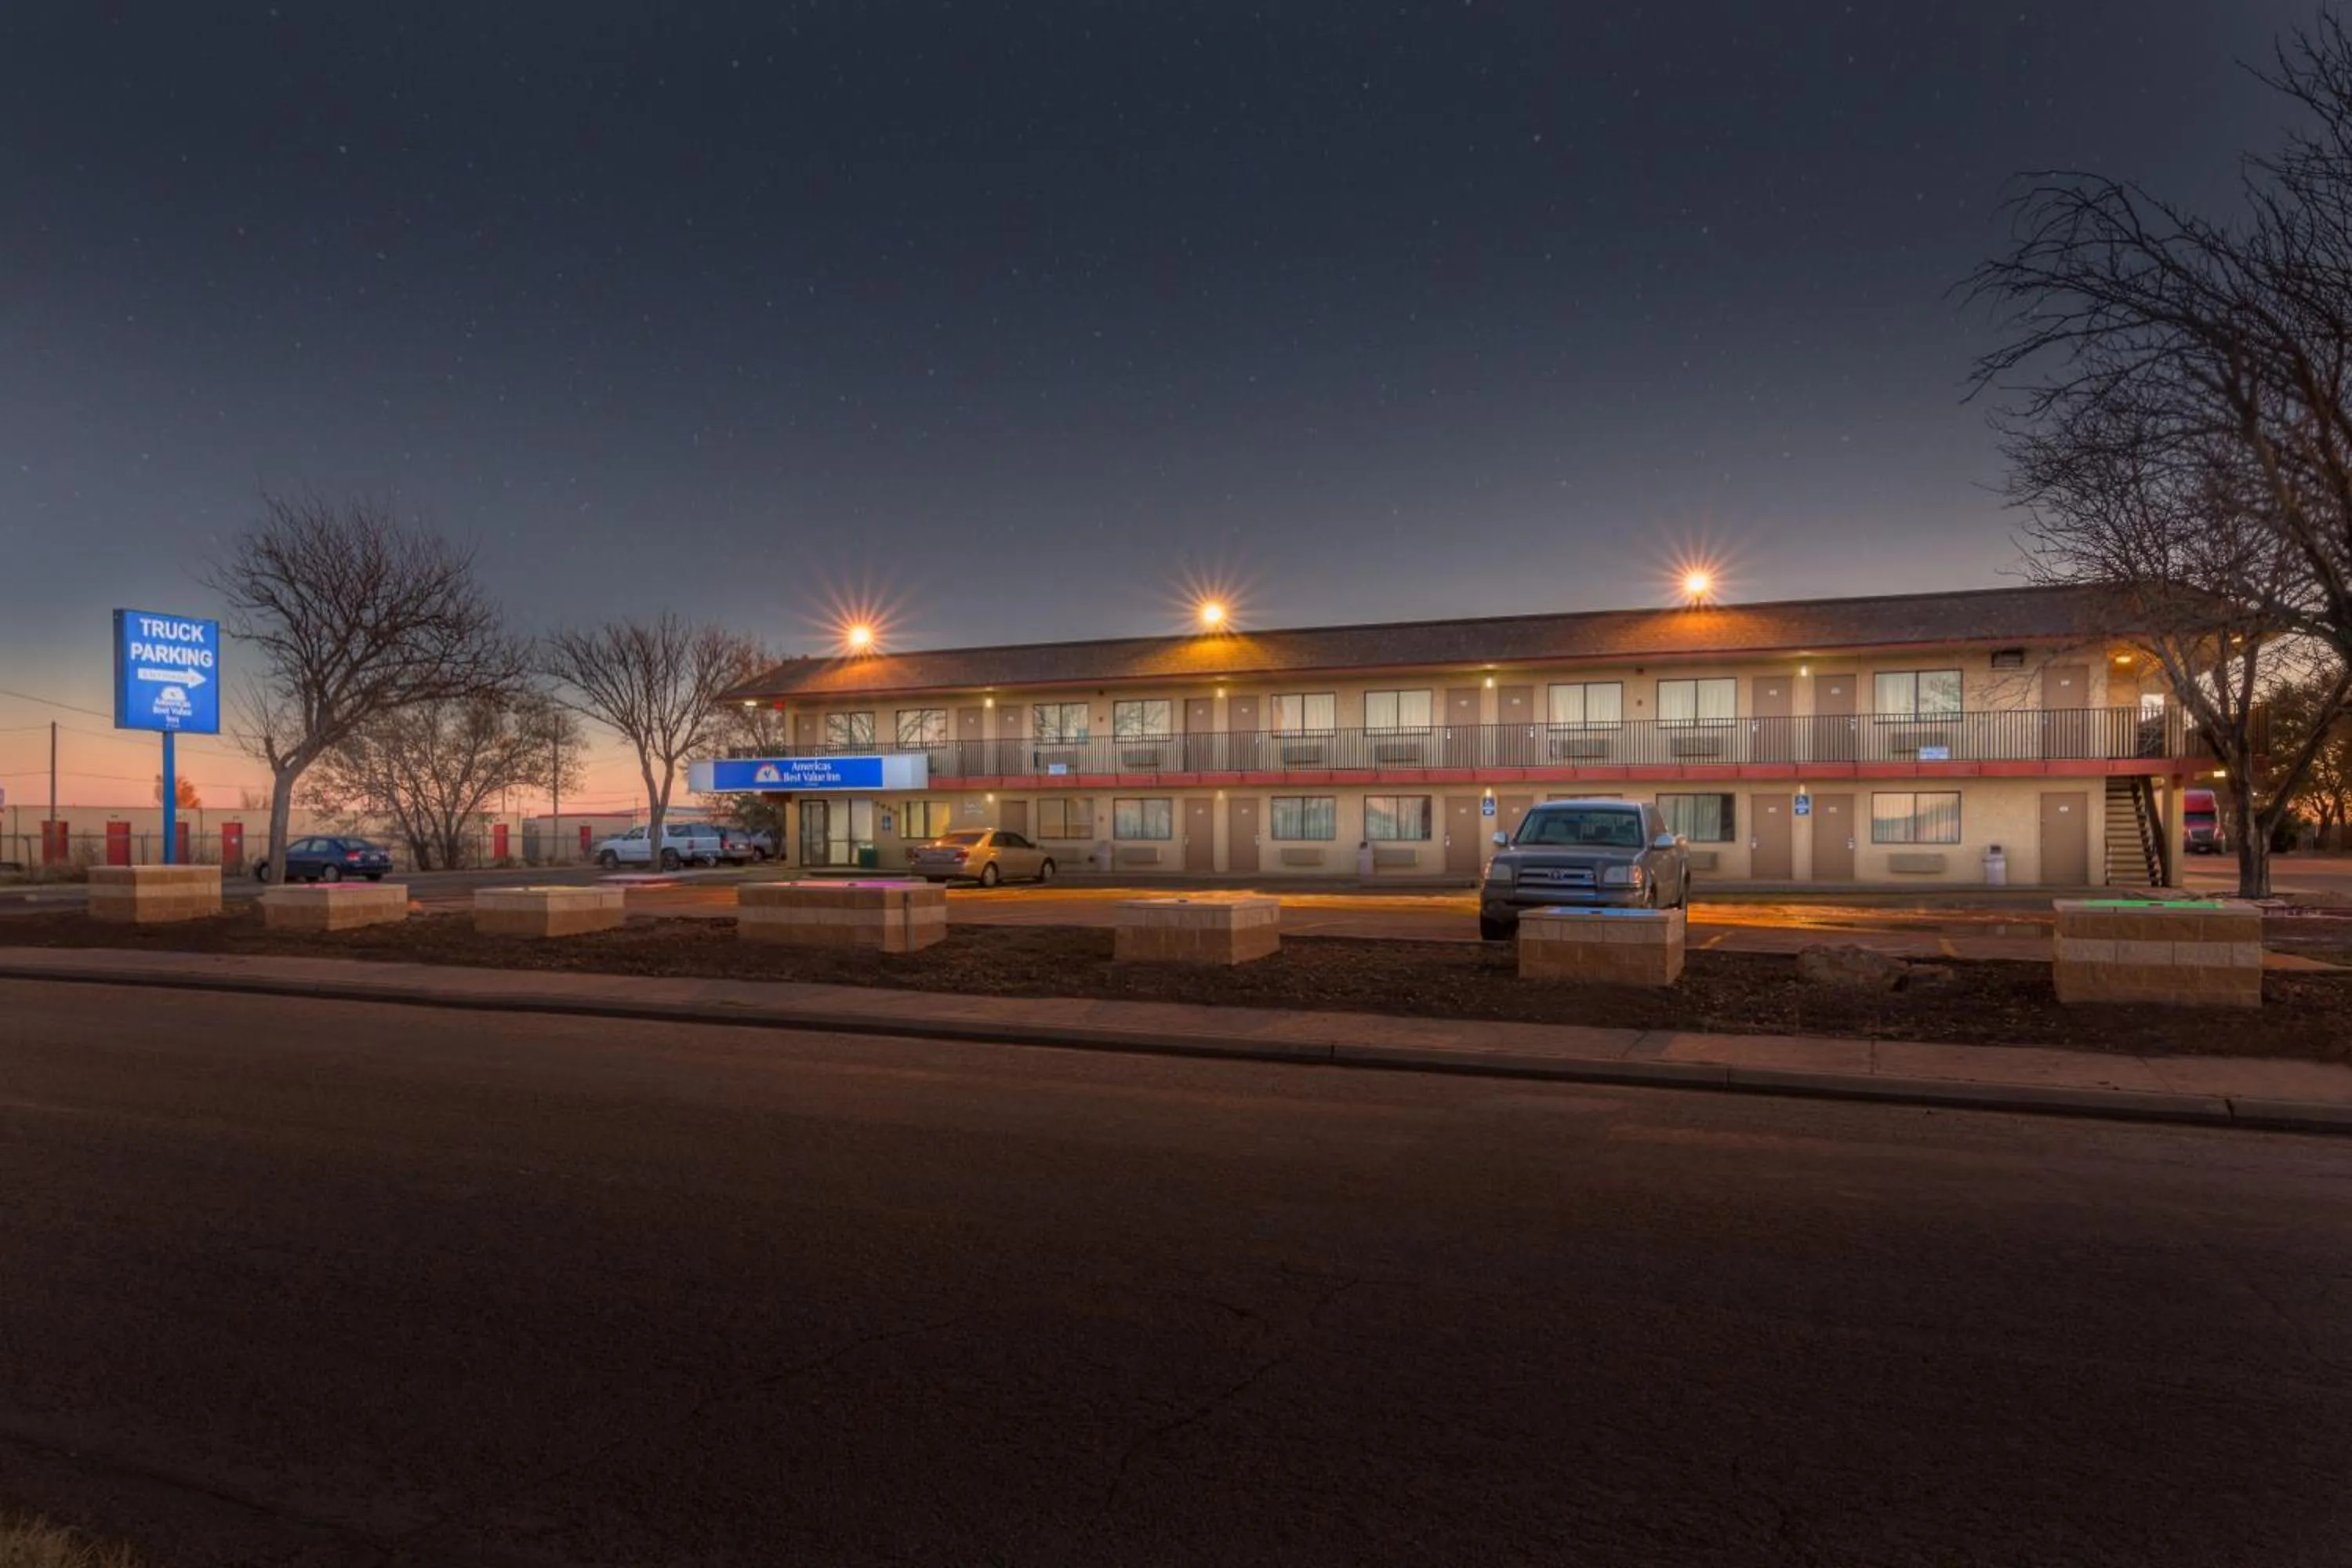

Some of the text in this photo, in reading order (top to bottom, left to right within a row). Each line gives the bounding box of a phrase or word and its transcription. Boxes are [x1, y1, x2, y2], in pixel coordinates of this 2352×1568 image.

[140, 618, 205, 643] TRUCK
[130, 641, 213, 668] PARKING
[802, 771, 826, 782] Value
